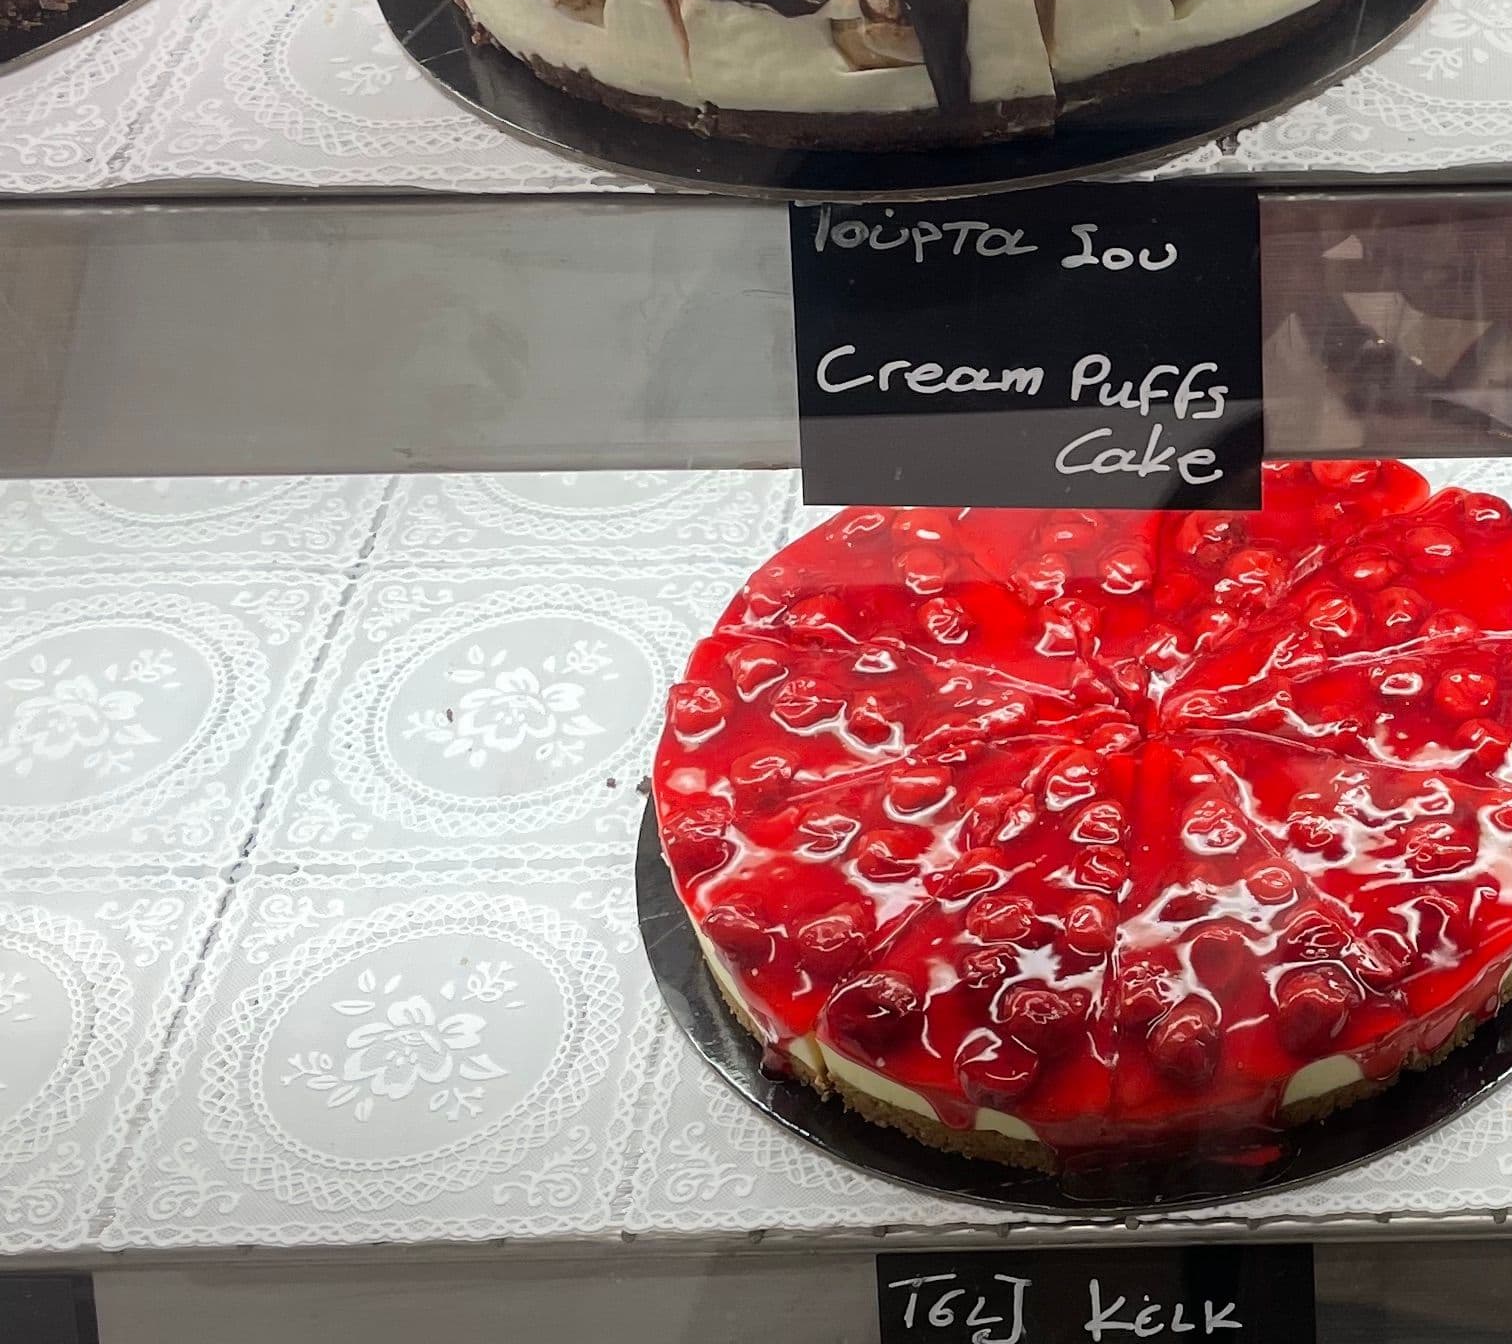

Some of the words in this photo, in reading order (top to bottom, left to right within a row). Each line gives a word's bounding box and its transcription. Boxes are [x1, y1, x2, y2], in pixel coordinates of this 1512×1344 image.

[1060, 224, 1178, 271] Σου
[816, 344, 1044, 396] Cream
[1054, 424, 1223, 485] Cake
